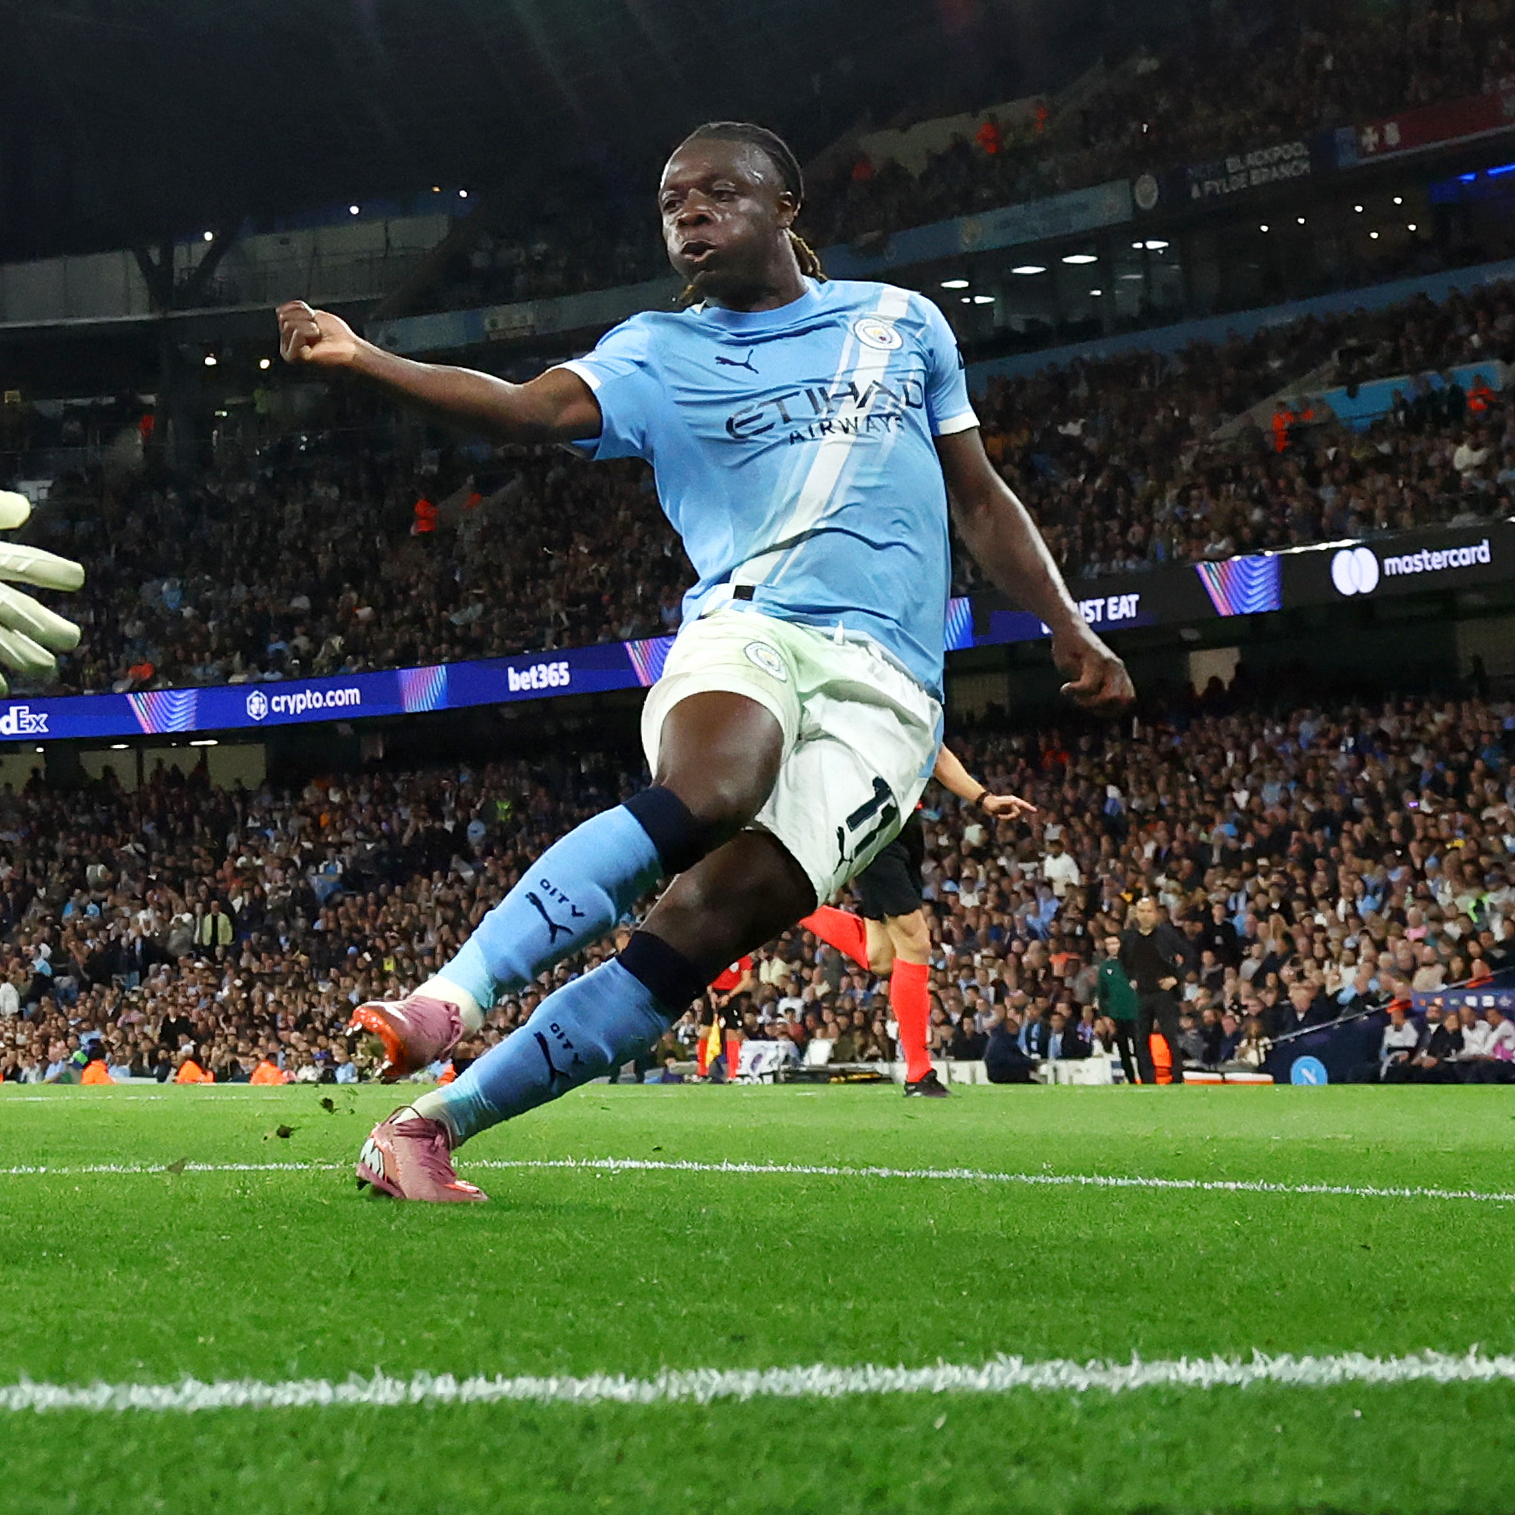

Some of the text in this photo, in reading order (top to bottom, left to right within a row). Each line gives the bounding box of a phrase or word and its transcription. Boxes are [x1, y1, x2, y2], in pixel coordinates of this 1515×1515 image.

[725, 378, 925, 440] ETIHAD
[789, 414, 906, 446] AIRWAYS
[1384, 539, 1491, 577] mastercard
[1107, 593, 1140, 621] EAT
[508, 661, 571, 692] bet365
[271, 685, 361, 716] crypto.com
